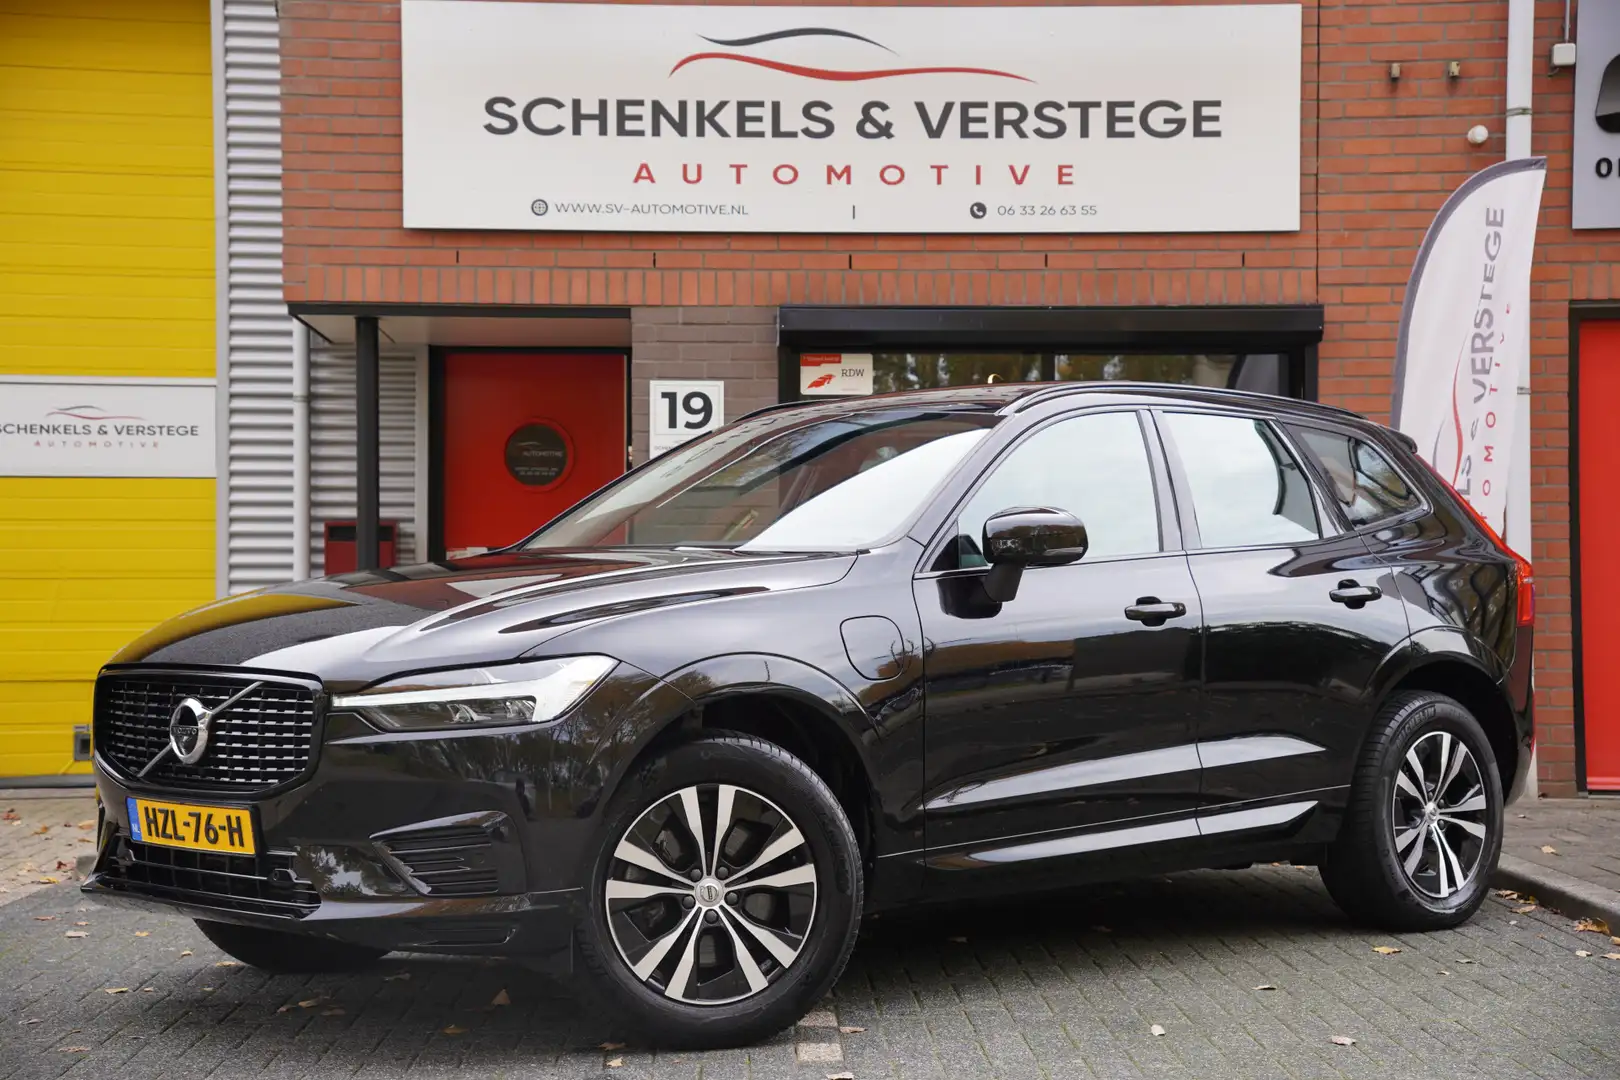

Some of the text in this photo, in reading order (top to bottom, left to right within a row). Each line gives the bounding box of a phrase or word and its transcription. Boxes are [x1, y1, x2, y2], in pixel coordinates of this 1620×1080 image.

[482, 96, 1222, 140] SCHENKELS & VERSTEGE
[632, 162, 1075, 186] AUTOMOTIVE
[555, 202, 749, 215] WWW.SV-AUTOMOTIVE.NL
[997, 205, 1097, 216] 06 33 26 63 55
[1470, 207, 1504, 404] VERSTEGE
[841, 368, 865, 377] RDW
[660, 391, 713, 430] 19
[0, 423, 199, 436] CHENKELS & VERSTEGE
[34, 440, 159, 448] AUTOMOTIVE
[132, 806, 245, 848] NL HZL-76-H
